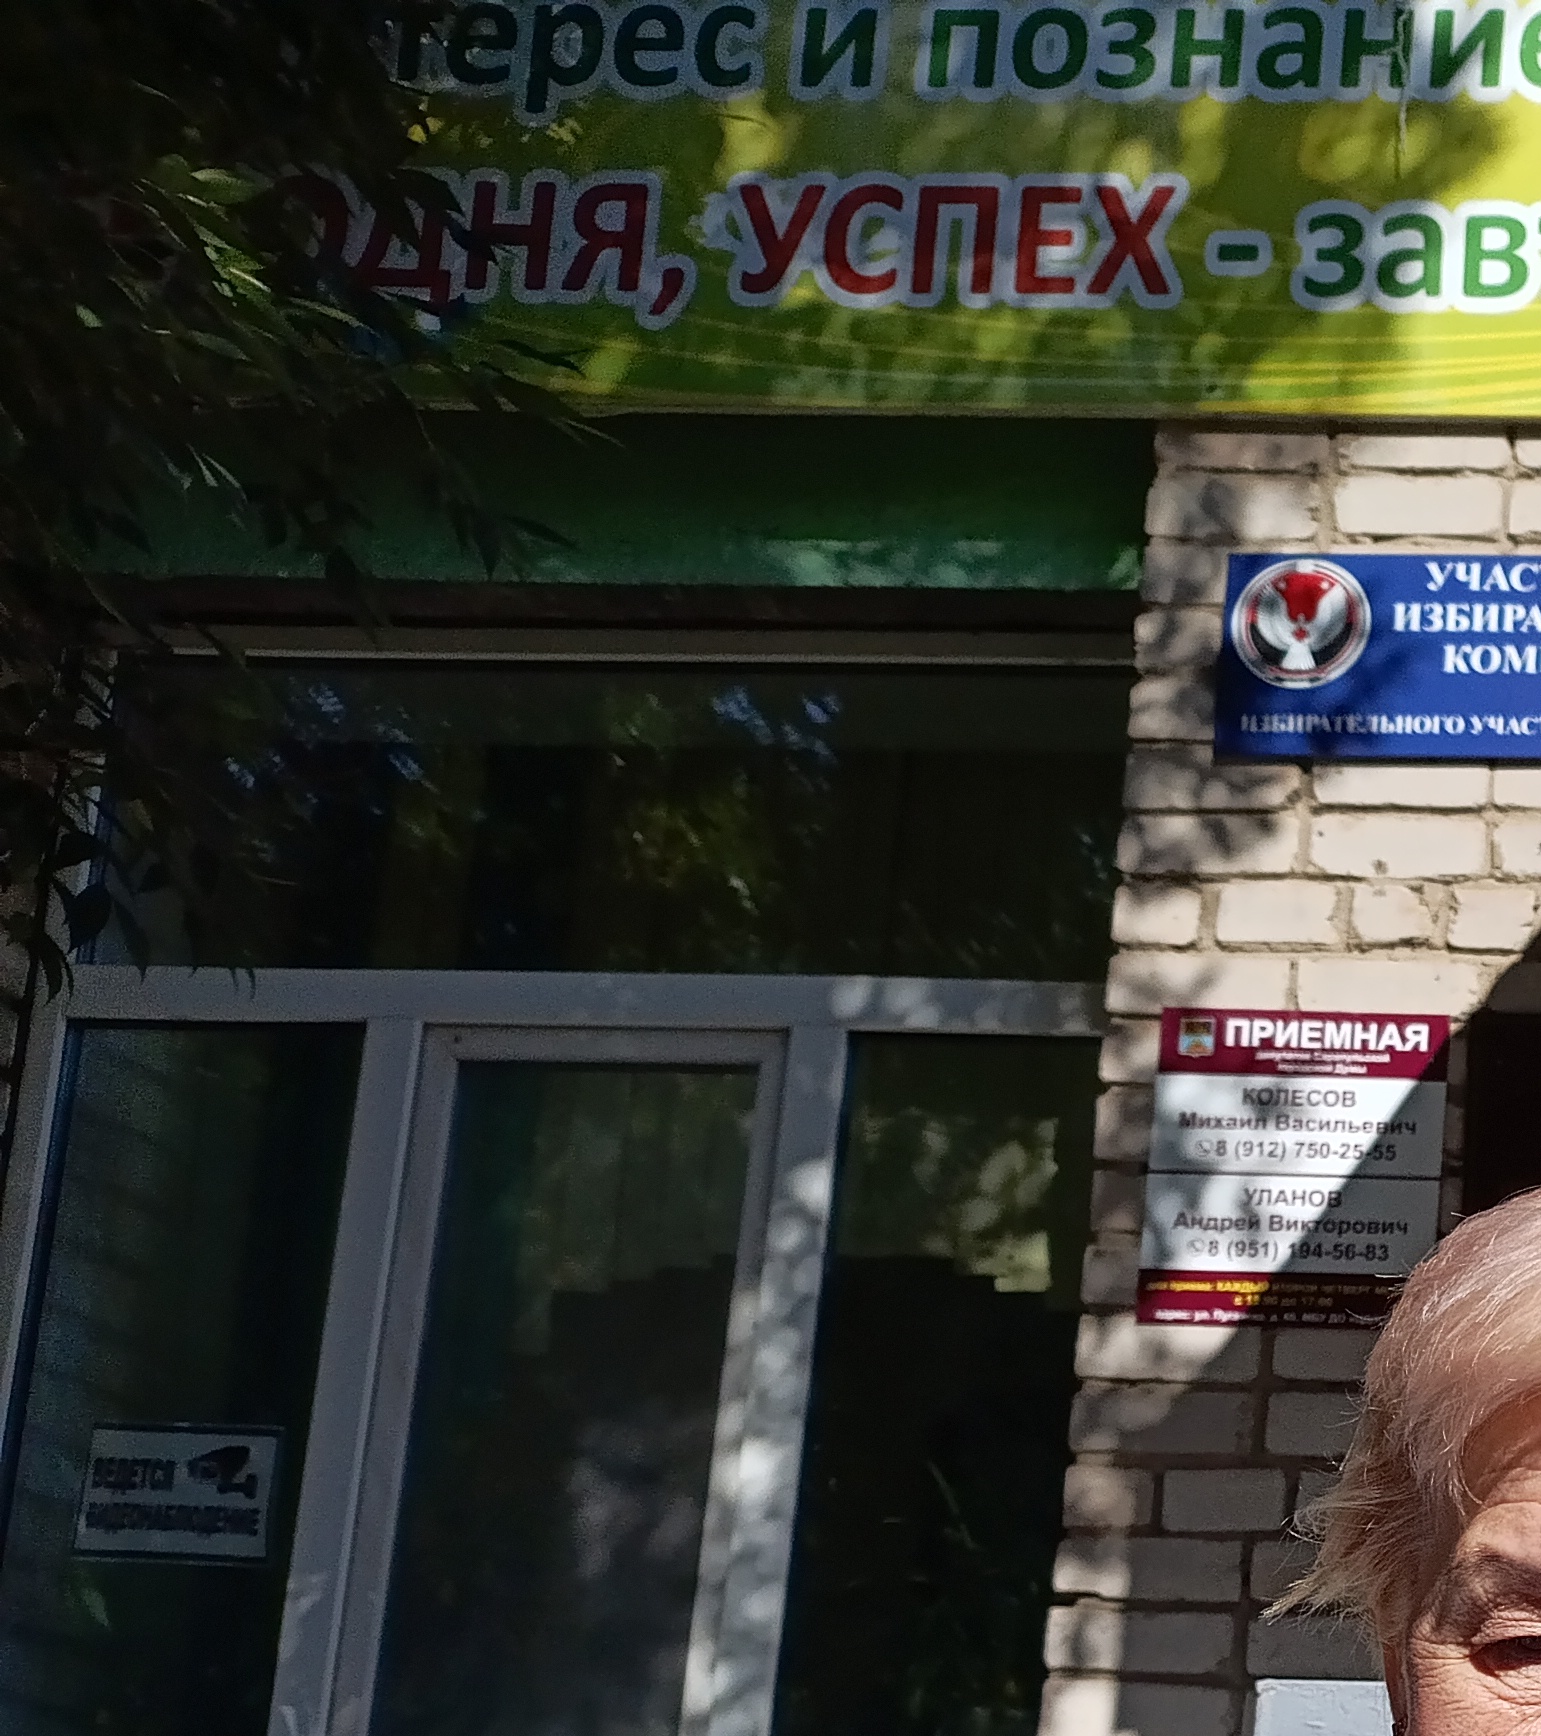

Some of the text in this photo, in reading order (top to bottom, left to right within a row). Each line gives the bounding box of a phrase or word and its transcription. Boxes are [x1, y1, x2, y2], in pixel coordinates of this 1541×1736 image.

[803, 7, 875, 88] и
[738, 182, 1176, 298] УСПЕХ
[1240, 713, 1466, 736] ИЗБИРАТЕЛЬНОГО
[1224, 1017, 1431, 1052] ПРИЕМНАЯ
[1242, 1087, 1356, 1108] КОЛЕСОВ
[1178, 1111, 1417, 1135] Михаил Васильевич
[1234, 1140, 1286, 1161] (912)
[1293, 1141, 1397, 1162] 750-25-55
[1243, 1187, 1343, 1208] УЛАНОВ
[1172, 1211, 1408, 1236] Андрей Викторович
[1227, 1240, 1279, 1262] (951)
[1288, 1241, 1390, 1262] 194-56-83
